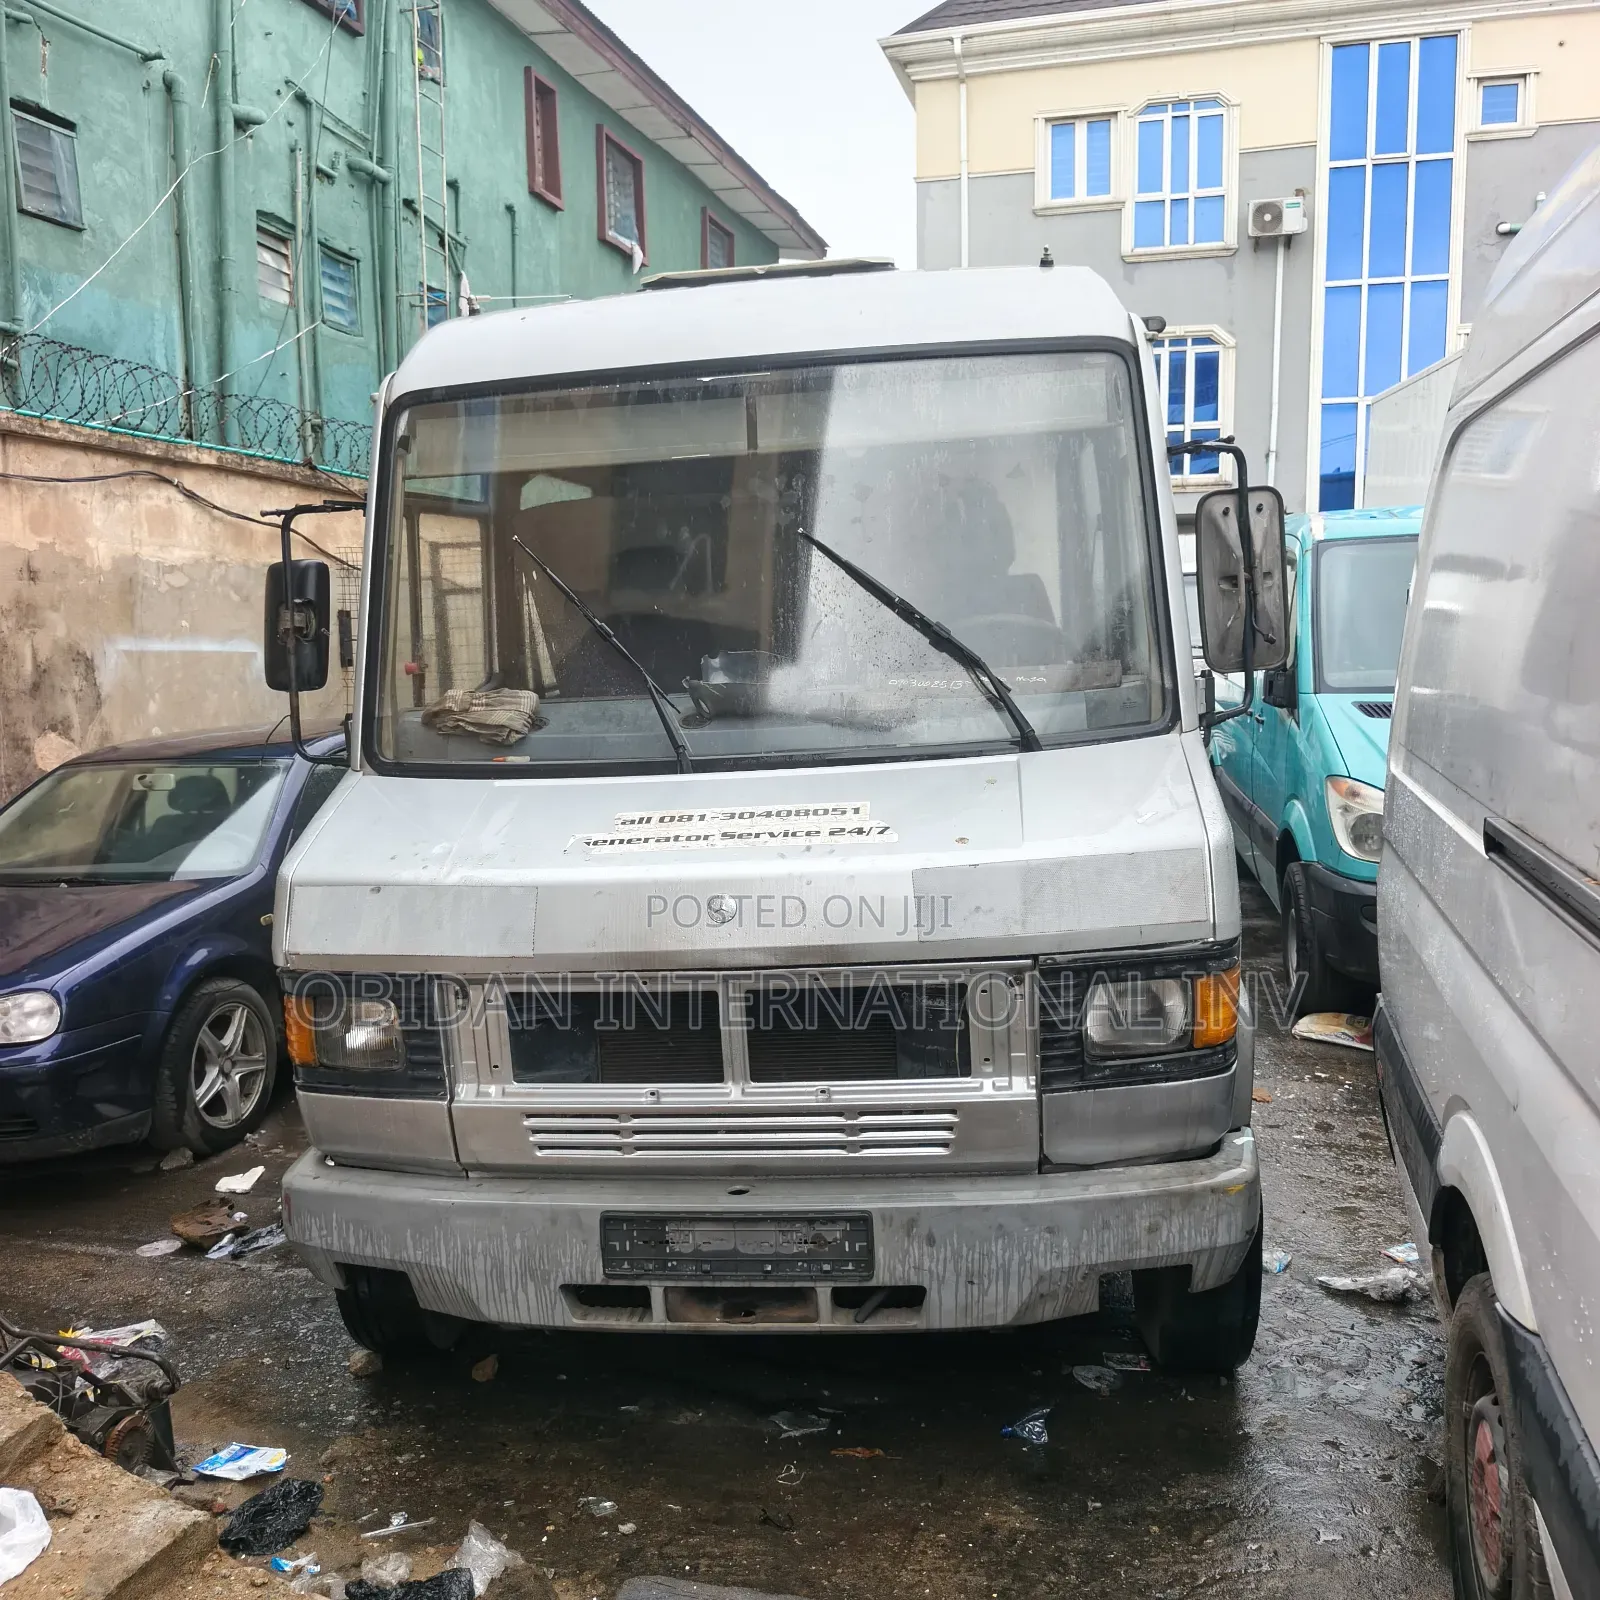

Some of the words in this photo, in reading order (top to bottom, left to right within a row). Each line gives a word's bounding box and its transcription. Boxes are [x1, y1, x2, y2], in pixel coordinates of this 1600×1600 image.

[658, 806, 861, 824] 081-30408051
[720, 829, 821, 842] Service
[828, 826, 891, 838] 24/7
